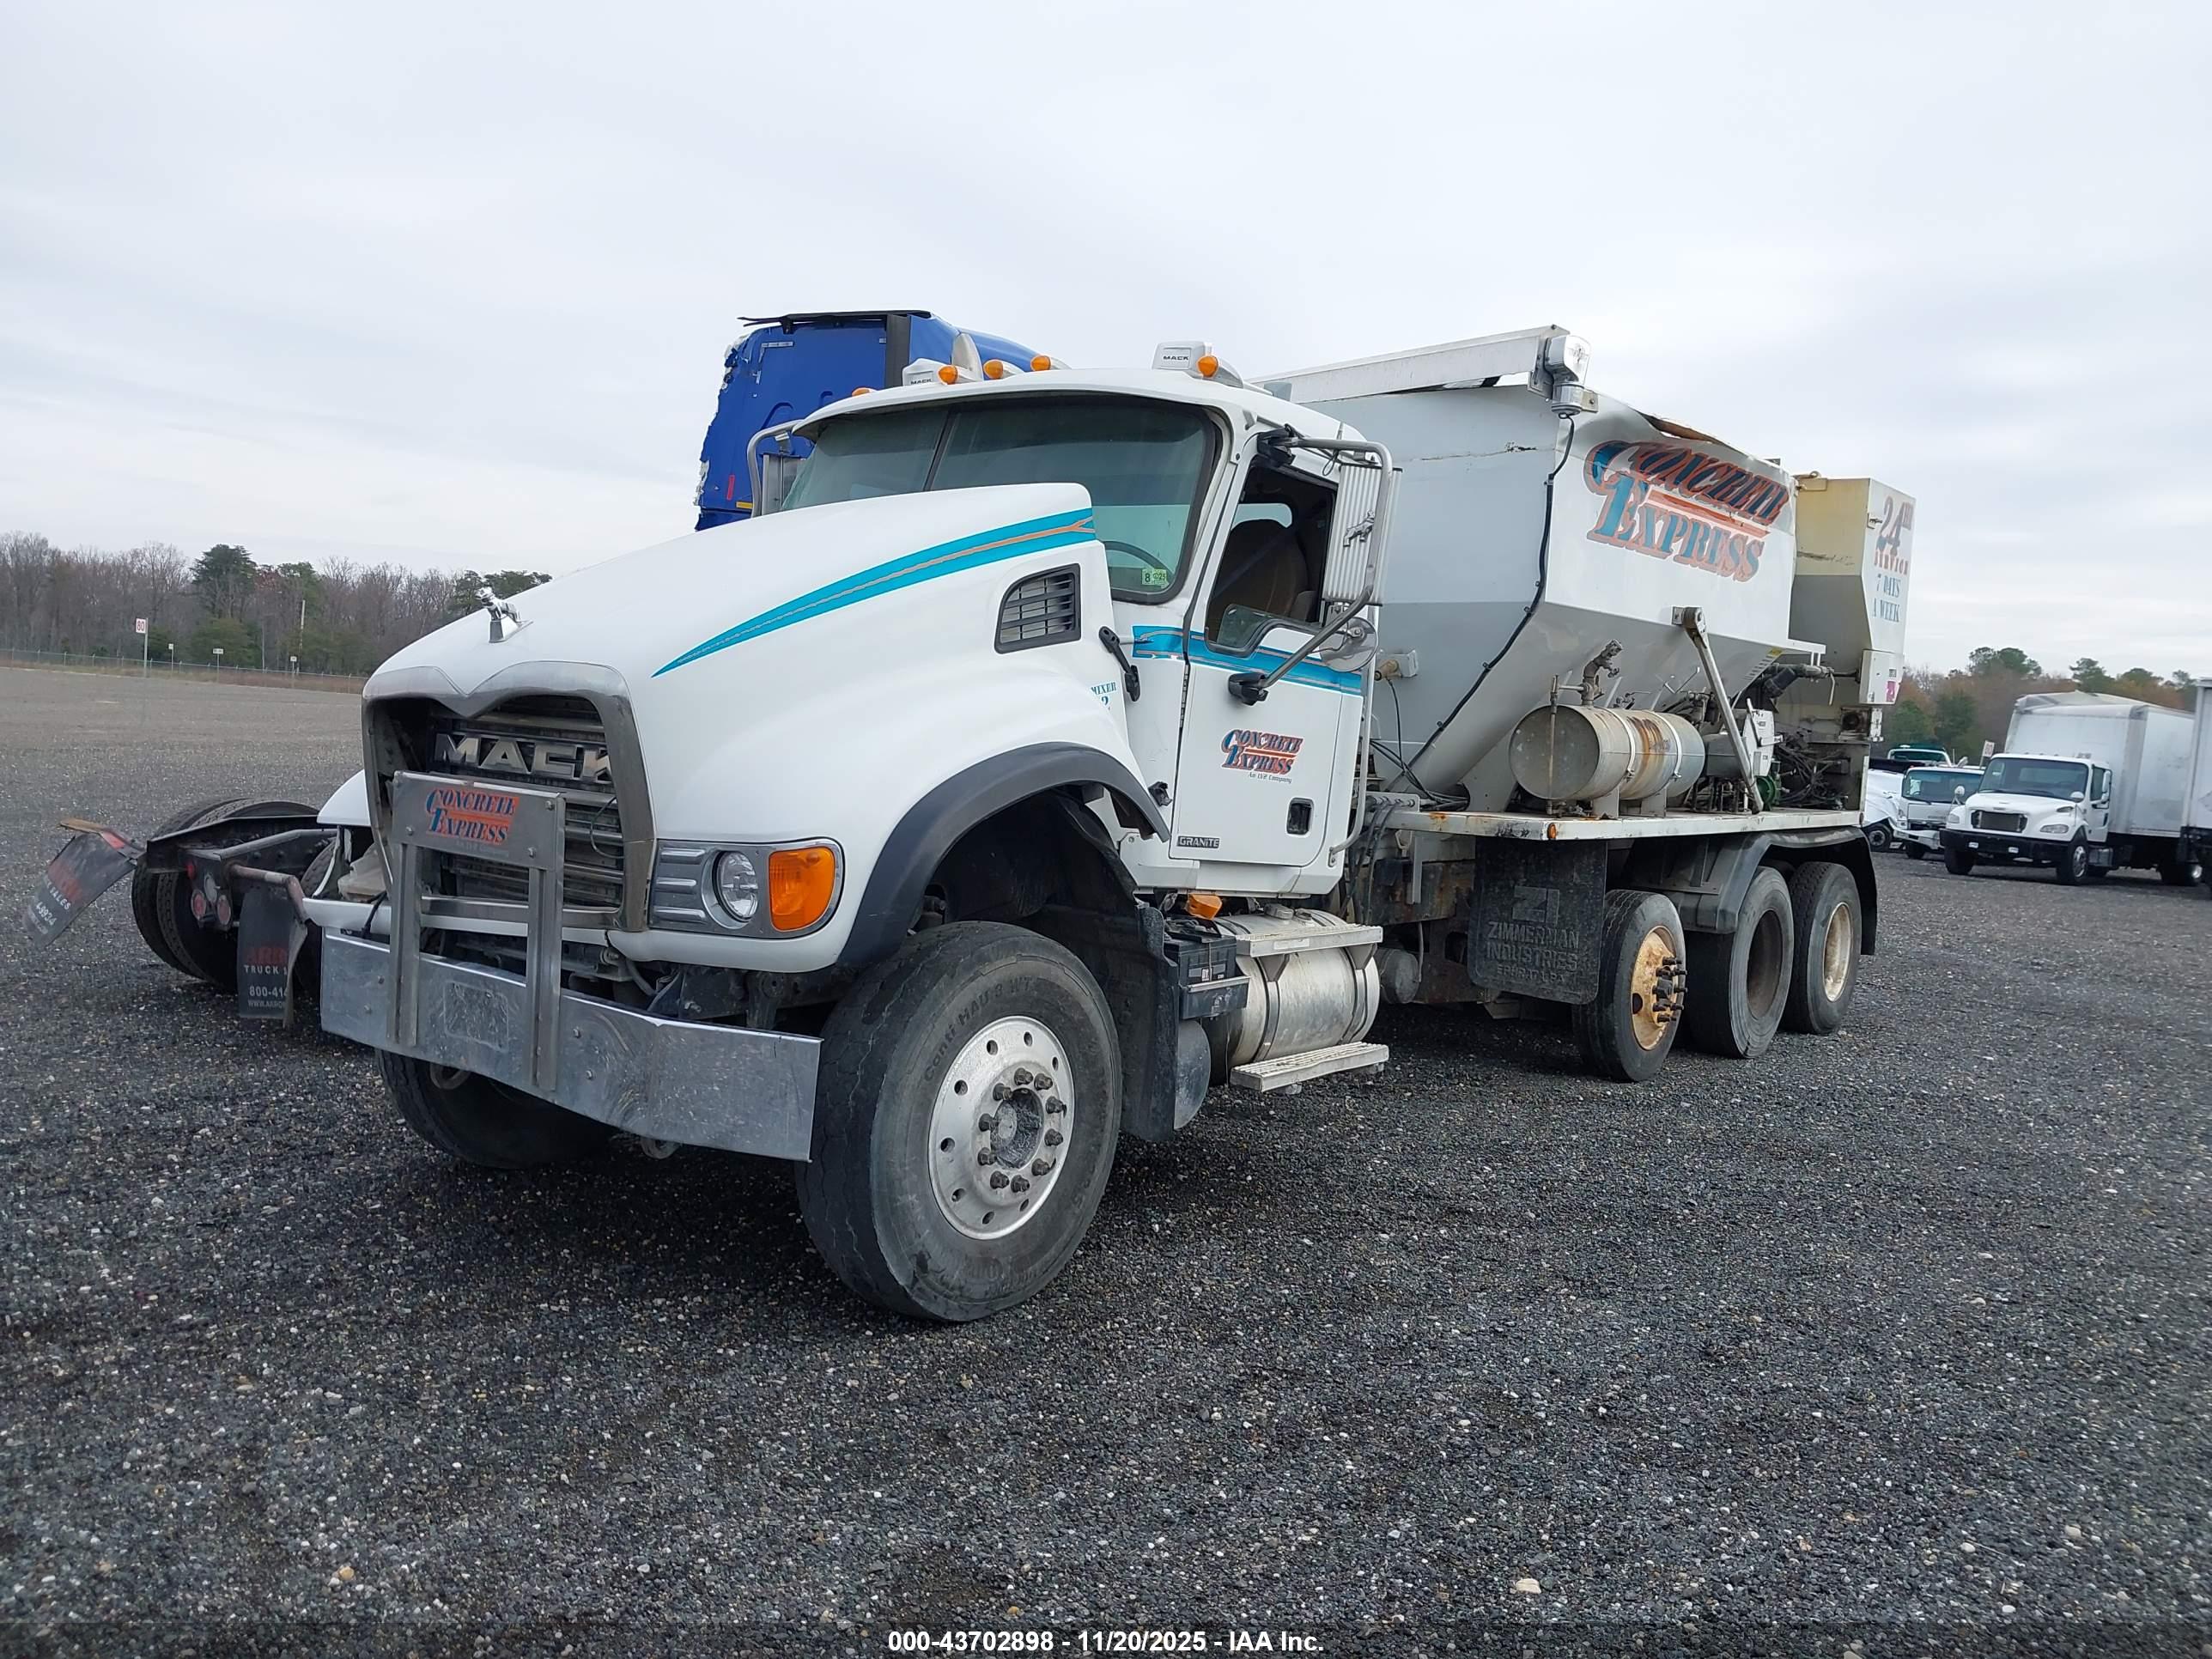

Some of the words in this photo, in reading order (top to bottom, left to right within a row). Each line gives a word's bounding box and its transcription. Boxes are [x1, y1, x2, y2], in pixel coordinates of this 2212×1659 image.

[1583, 440, 1790, 526] CONCRETE
[1587, 474, 1765, 583] EXPRESS
[1145, 573, 1151, 583] 8
[1883, 575, 1901, 599] DAYS
[1880, 599, 1899, 623] WEEK
[1091, 682, 1116, 696] MIXER
[1221, 729, 1304, 754] CONCRETE
[434, 732, 612, 785] MACK
[1221, 744, 1294, 775] EXPRESS
[426, 788, 518, 817] CONCRETE
[428, 807, 510, 844] EXPRESS
[1488, 921, 1580, 949] ZIMMERMAN
[243, 964, 279, 975] TRUCK
[1486, 942, 1578, 971] INDUSTRIES
